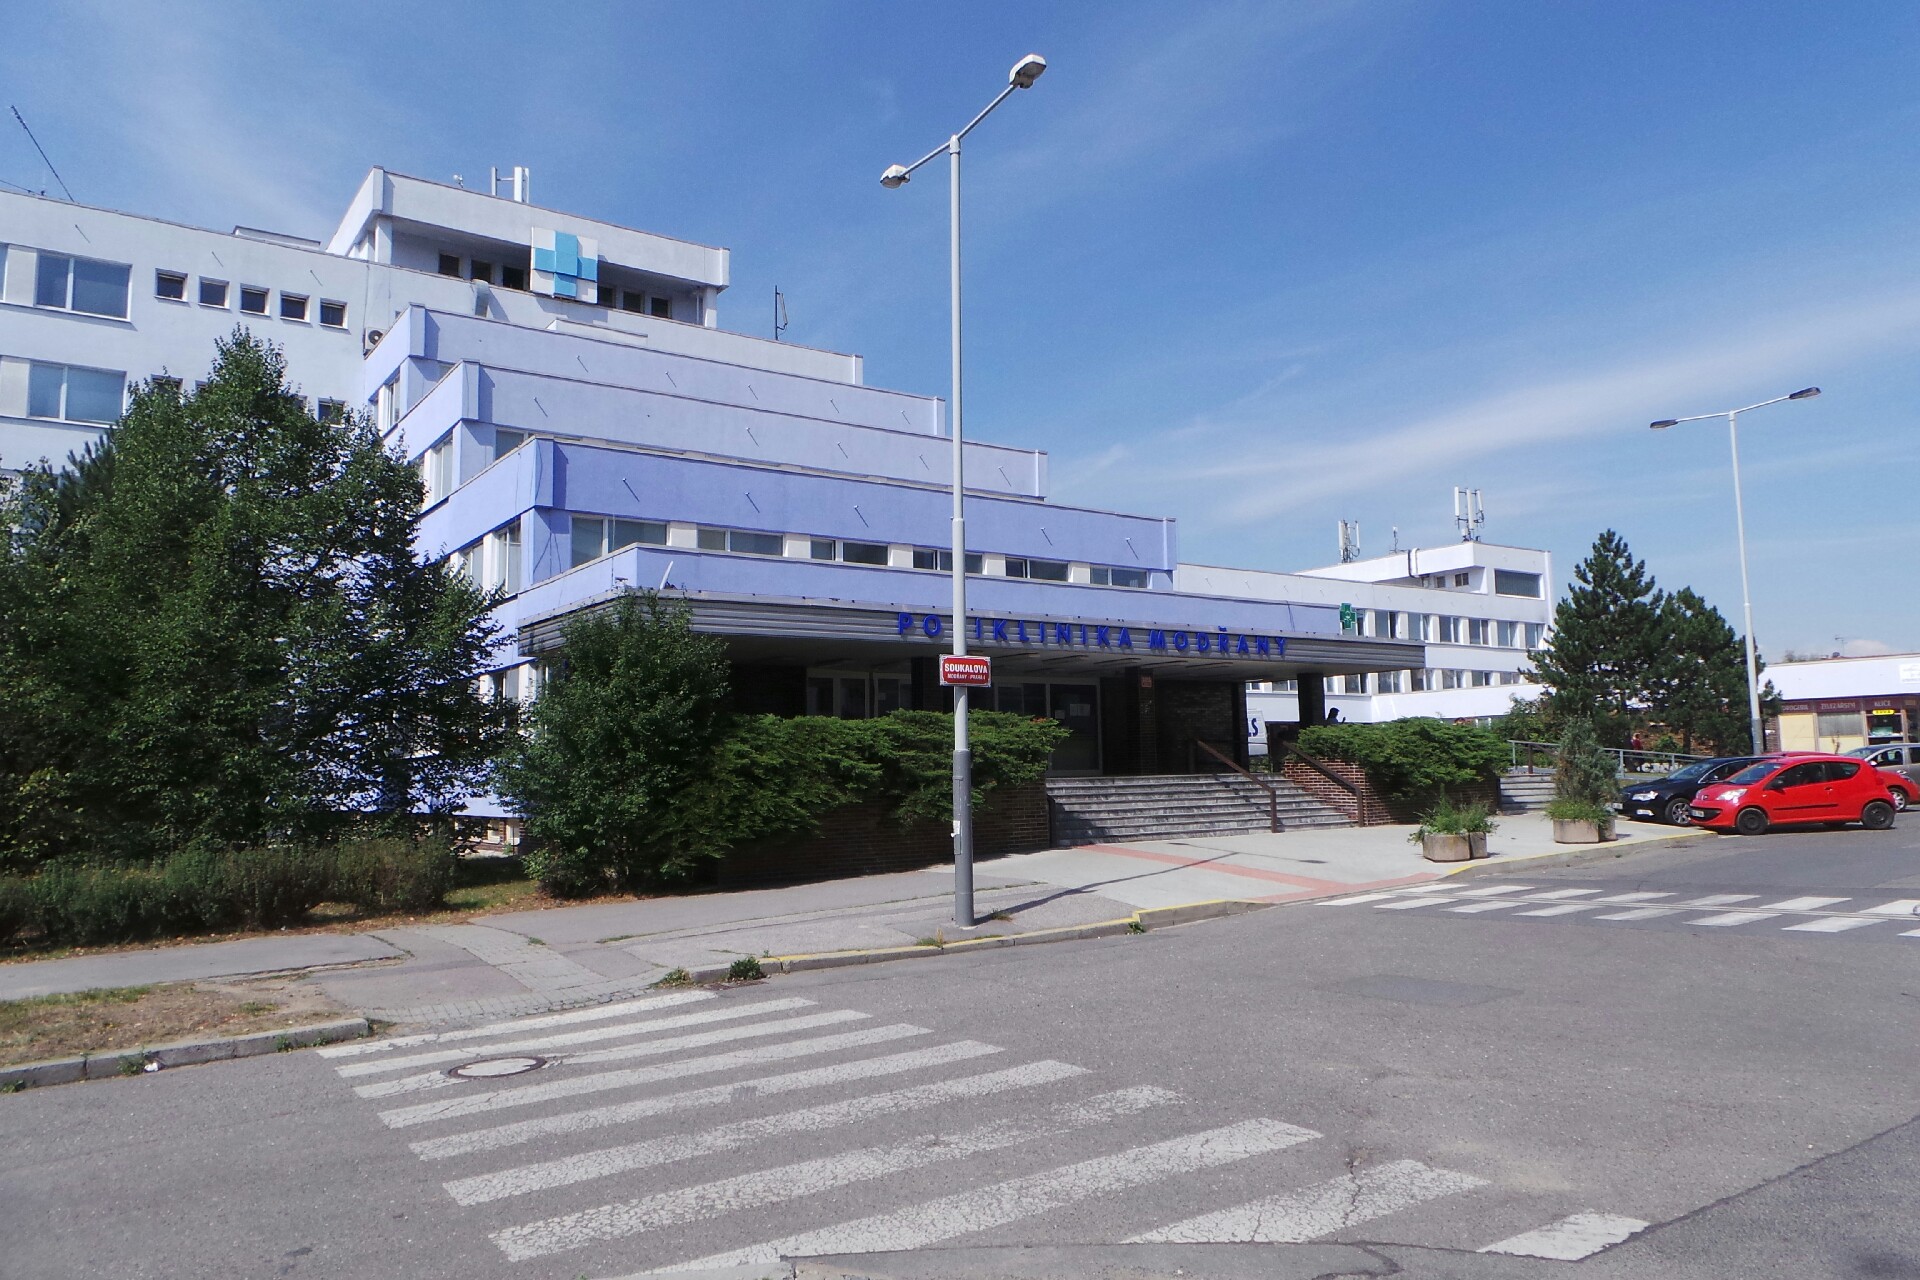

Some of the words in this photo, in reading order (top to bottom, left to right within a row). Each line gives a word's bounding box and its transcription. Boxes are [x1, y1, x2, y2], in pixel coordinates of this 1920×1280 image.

[898, 612, 1132, 648] POIKLINIKA
[1149, 625, 1286, 656] MODŘANY
[944, 663, 988, 674] SOUKALOVA
